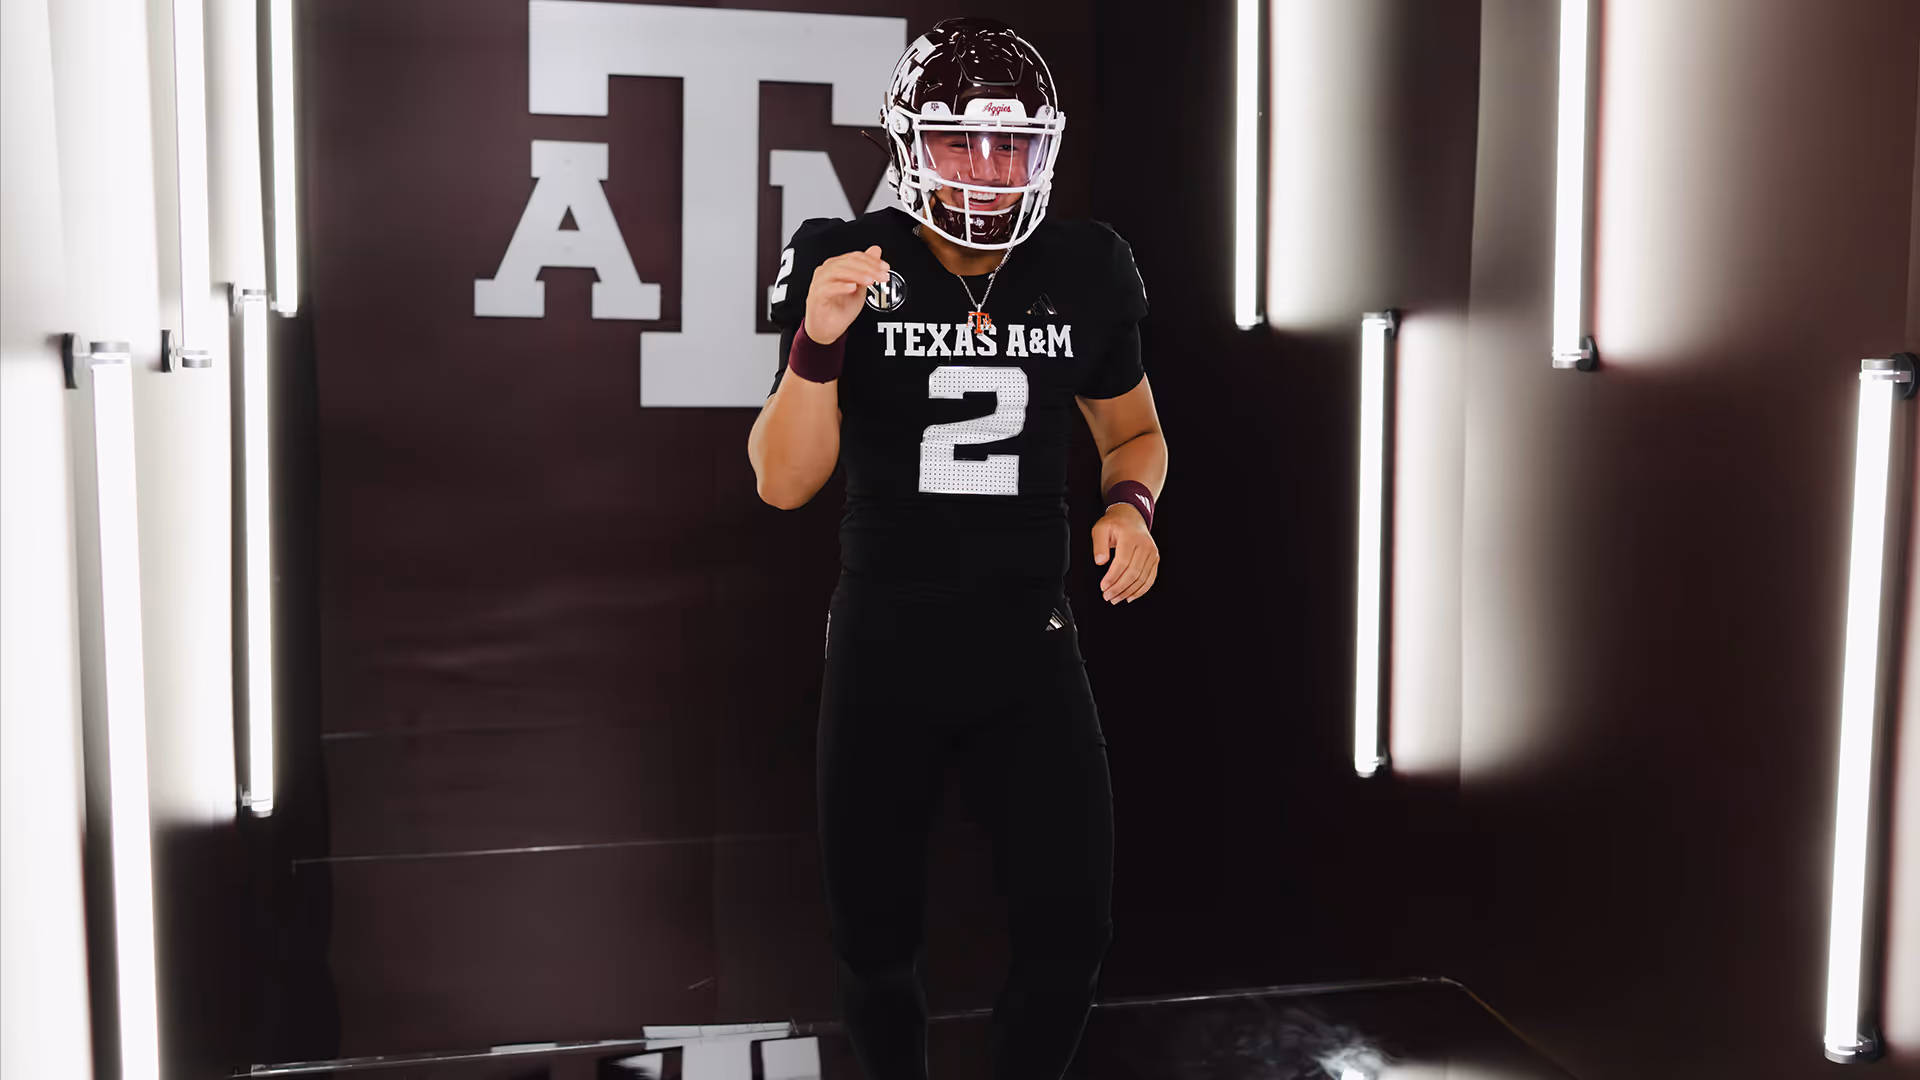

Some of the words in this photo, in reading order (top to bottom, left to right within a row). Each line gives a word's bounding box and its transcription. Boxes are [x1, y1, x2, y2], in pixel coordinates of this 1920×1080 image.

[982, 102, 1012, 117] Aggies
[771, 247, 795, 304] 2
[866, 274, 903, 309] SEC
[877, 322, 997, 358] TEXAS
[1006, 324, 1074, 358] A&M
[918, 366, 1029, 496] 2
